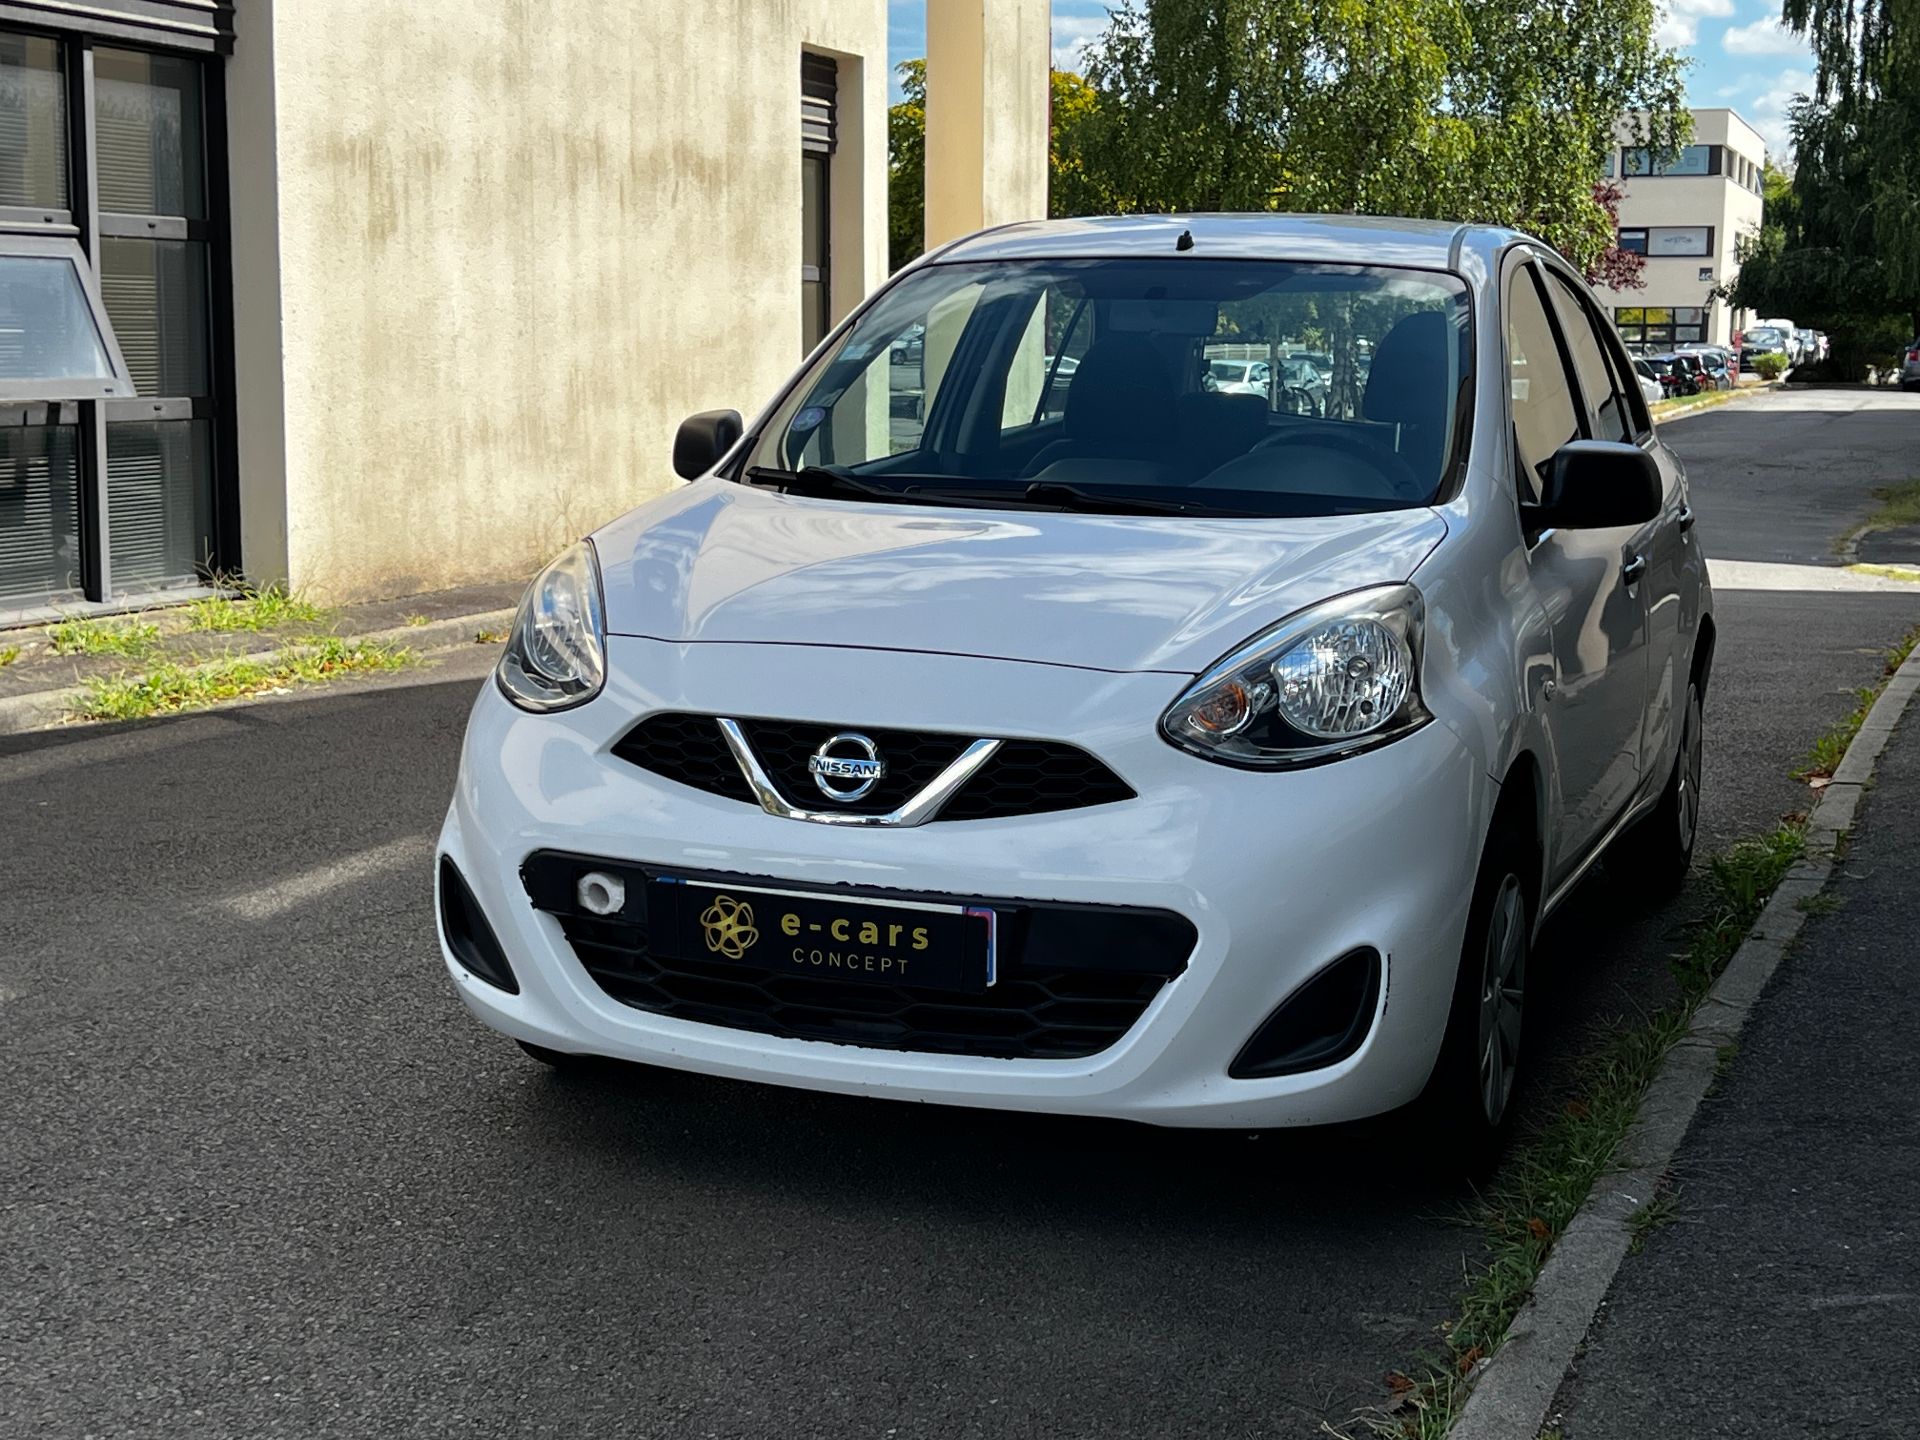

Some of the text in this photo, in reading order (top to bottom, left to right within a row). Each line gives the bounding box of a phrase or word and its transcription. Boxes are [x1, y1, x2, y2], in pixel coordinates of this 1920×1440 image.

[815, 760, 875, 775] NISSAN
[781, 913, 929, 950] e-cars
[792, 948, 908, 974] CONCEPT
